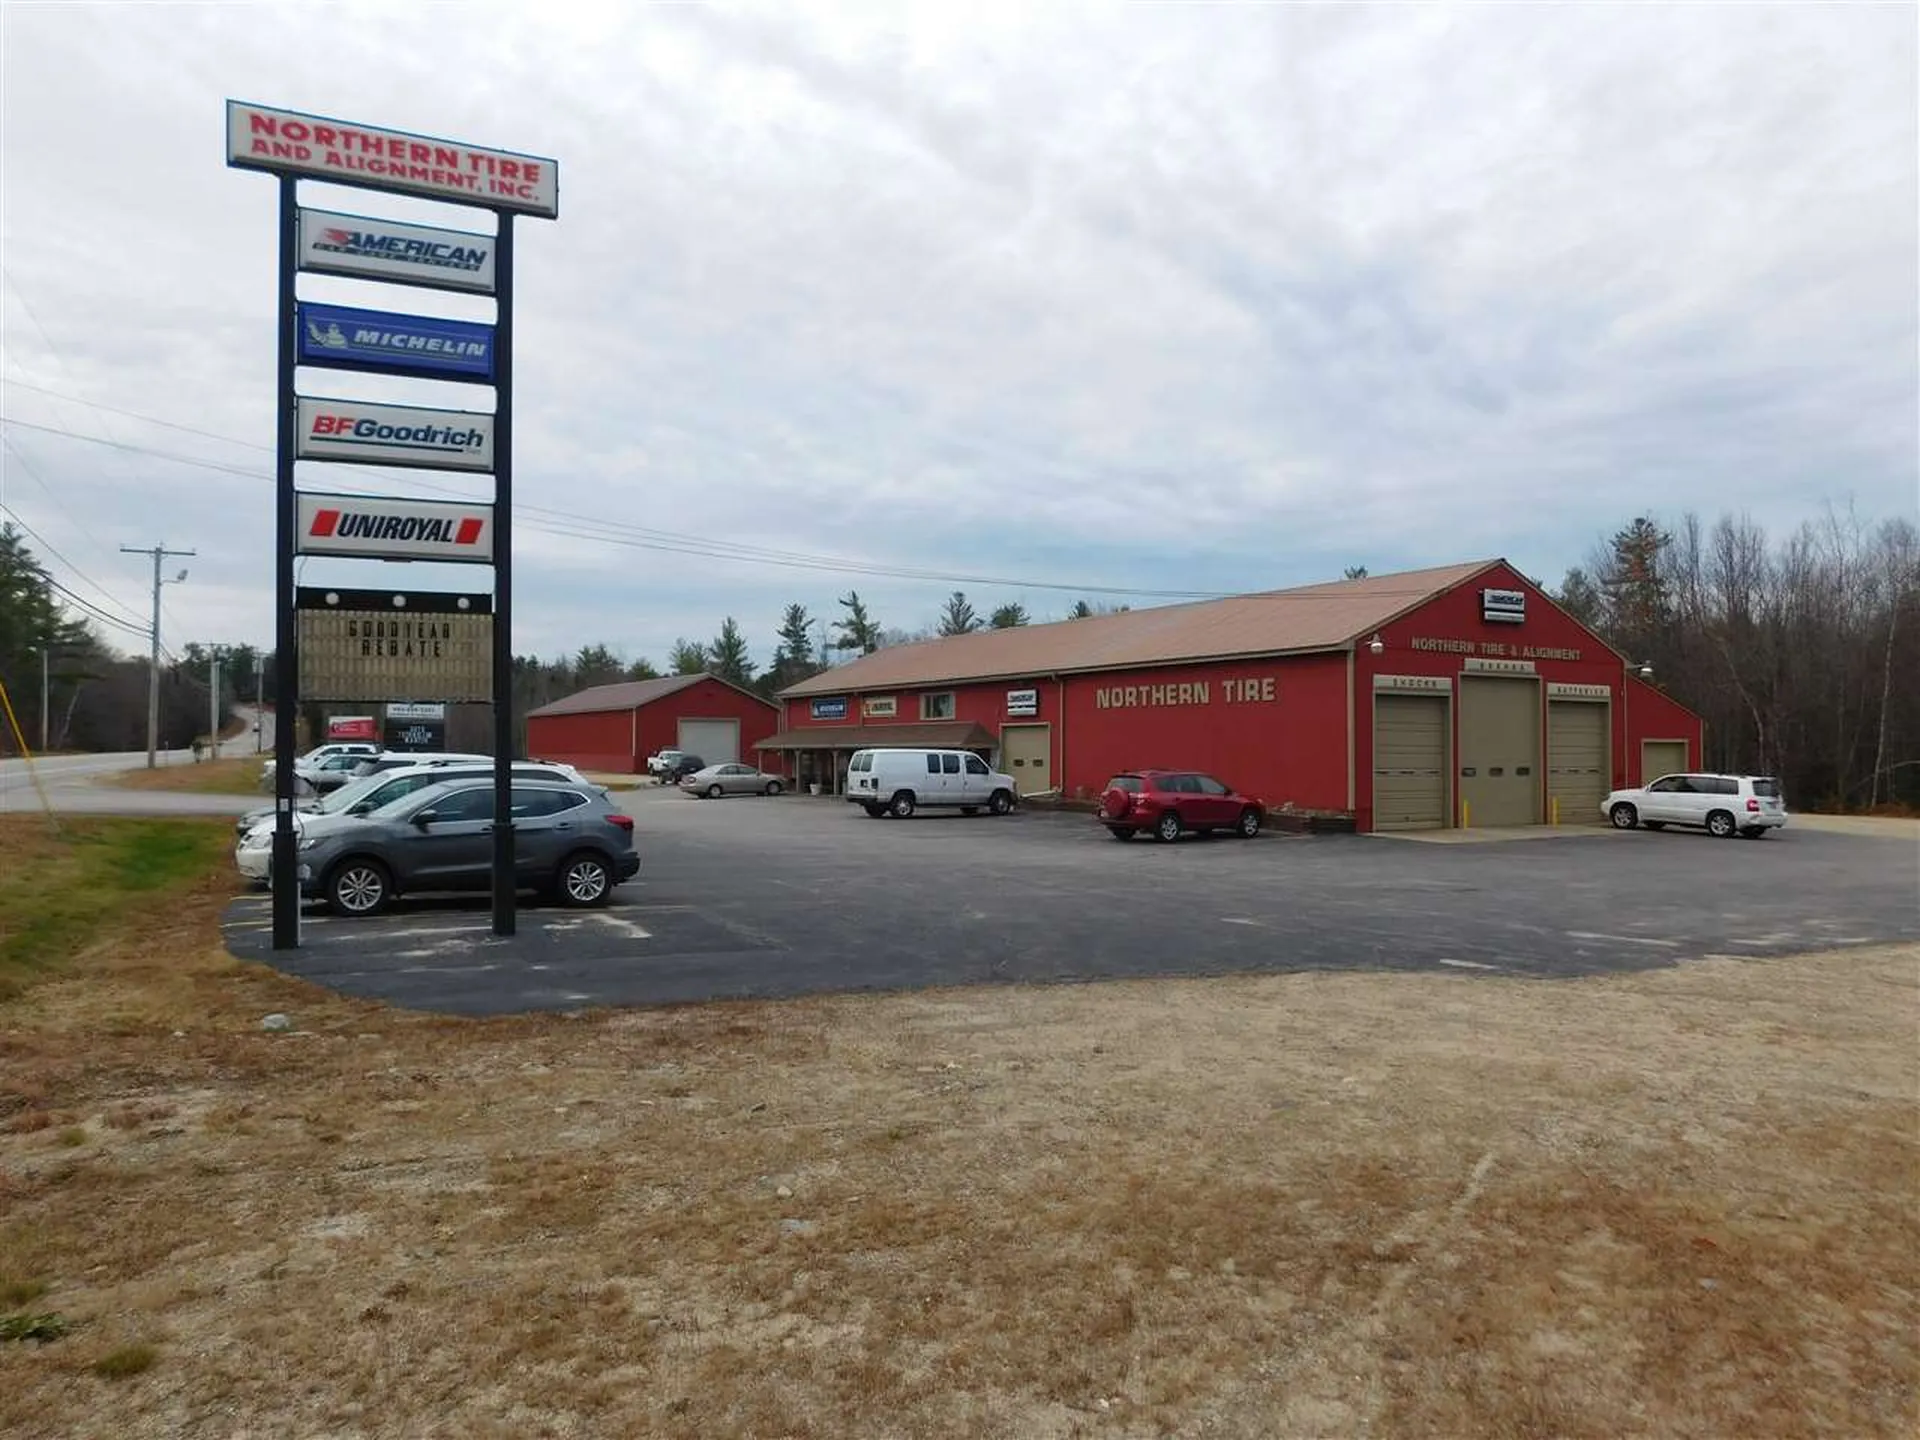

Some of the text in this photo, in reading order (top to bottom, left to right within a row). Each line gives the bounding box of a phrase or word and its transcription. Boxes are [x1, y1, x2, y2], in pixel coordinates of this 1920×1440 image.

[249, 114, 541, 184] NORTHERN TIRE
[251, 139, 540, 201] AND ALIGNMENT, INC.
[346, 231, 487, 265] AMERICAN
[353, 329, 486, 357] MICHELIN
[312, 415, 484, 447] BFGoodrich
[337, 513, 453, 543] UNIROYAL
[348, 620, 450, 639] GOODYEAR
[362, 639, 441, 658] REBATE
[1411, 636, 1582, 661] NORTHERN TIRE & ALIGNMENT
[1096, 677, 1276, 709] NORTHERN TIRE
